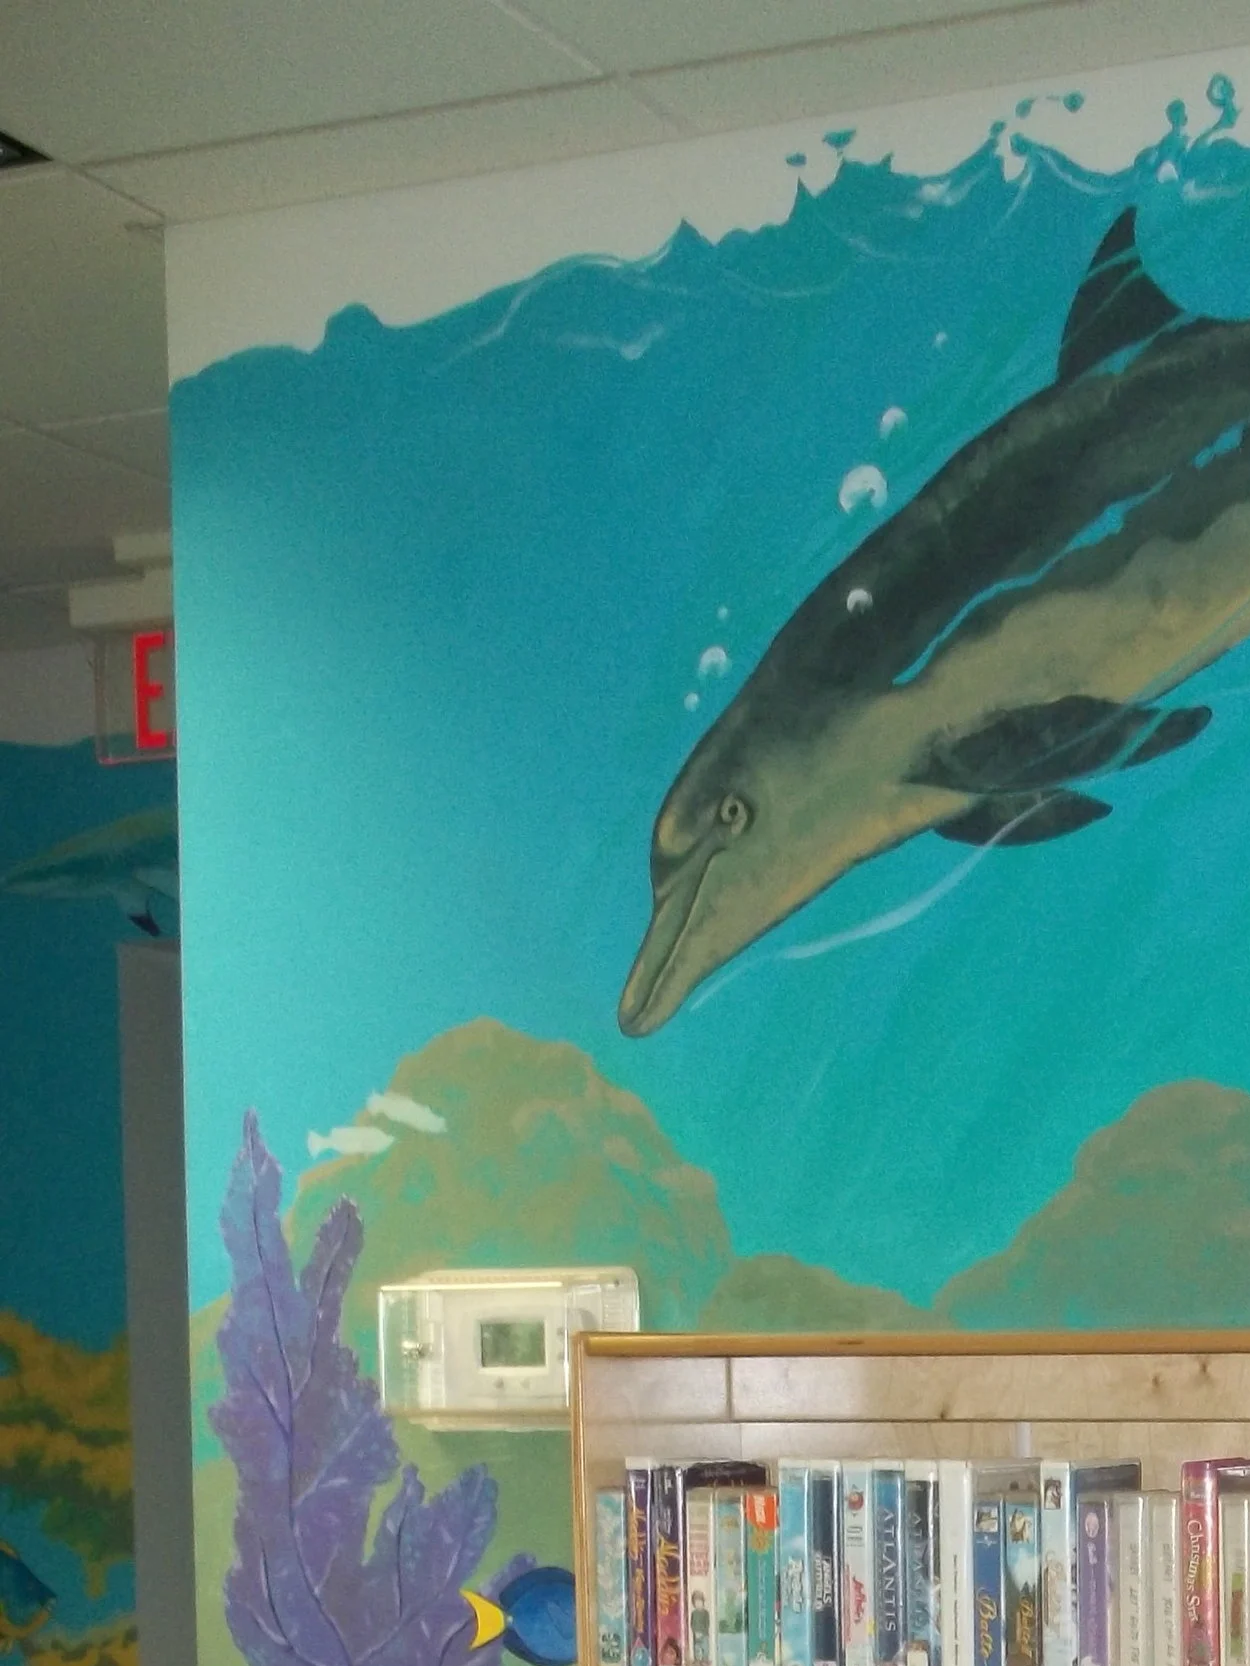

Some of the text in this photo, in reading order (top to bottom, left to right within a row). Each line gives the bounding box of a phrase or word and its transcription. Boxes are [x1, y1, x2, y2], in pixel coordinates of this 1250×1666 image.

[657, 1534, 681, 1617] Aladdin
[882, 1508, 897, 1632] ATLANTIS
[909, 1512, 923, 1634] ATLANTIS
[1186, 1520, 1203, 1593] Christmas
